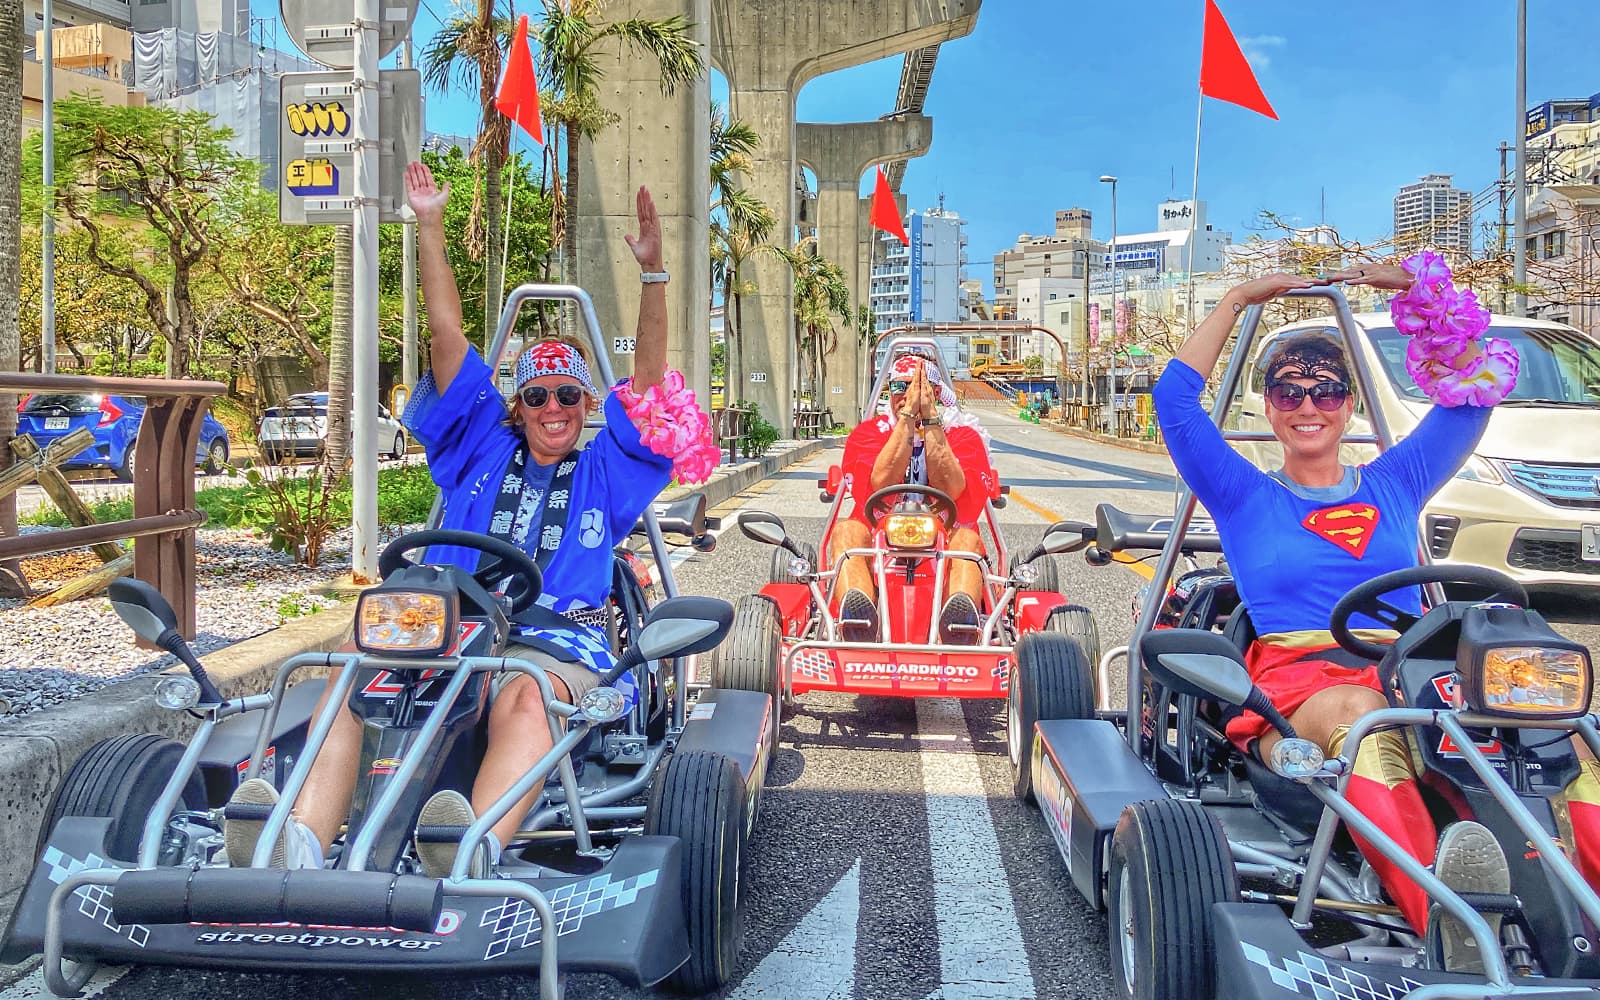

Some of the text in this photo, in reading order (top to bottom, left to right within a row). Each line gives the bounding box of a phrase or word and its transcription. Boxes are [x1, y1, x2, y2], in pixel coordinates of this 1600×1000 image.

[615, 339, 636, 351] P33
[845, 662, 979, 677] STANDARDMOTO
[852, 674, 974, 683] streetpower
[197, 930, 442, 950] streetpower
